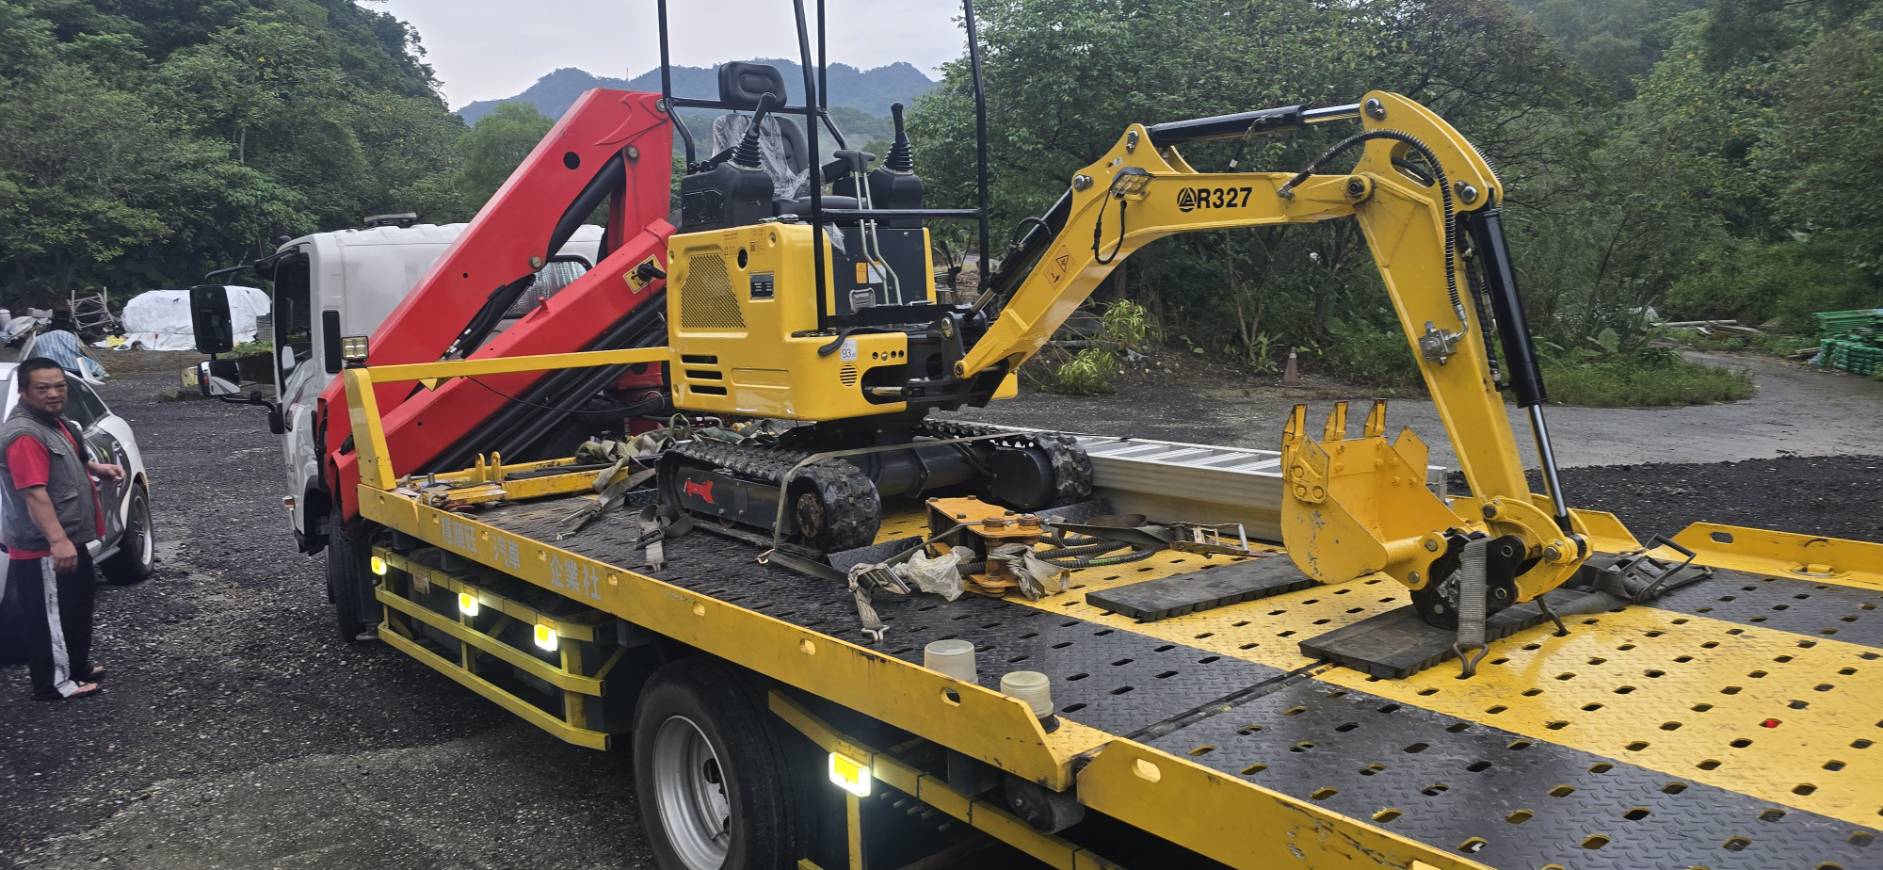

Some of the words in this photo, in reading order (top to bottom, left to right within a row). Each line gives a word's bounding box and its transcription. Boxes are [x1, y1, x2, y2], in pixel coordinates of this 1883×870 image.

[1196, 187, 1253, 209] R327
[551, 553, 601, 600] 企業社
